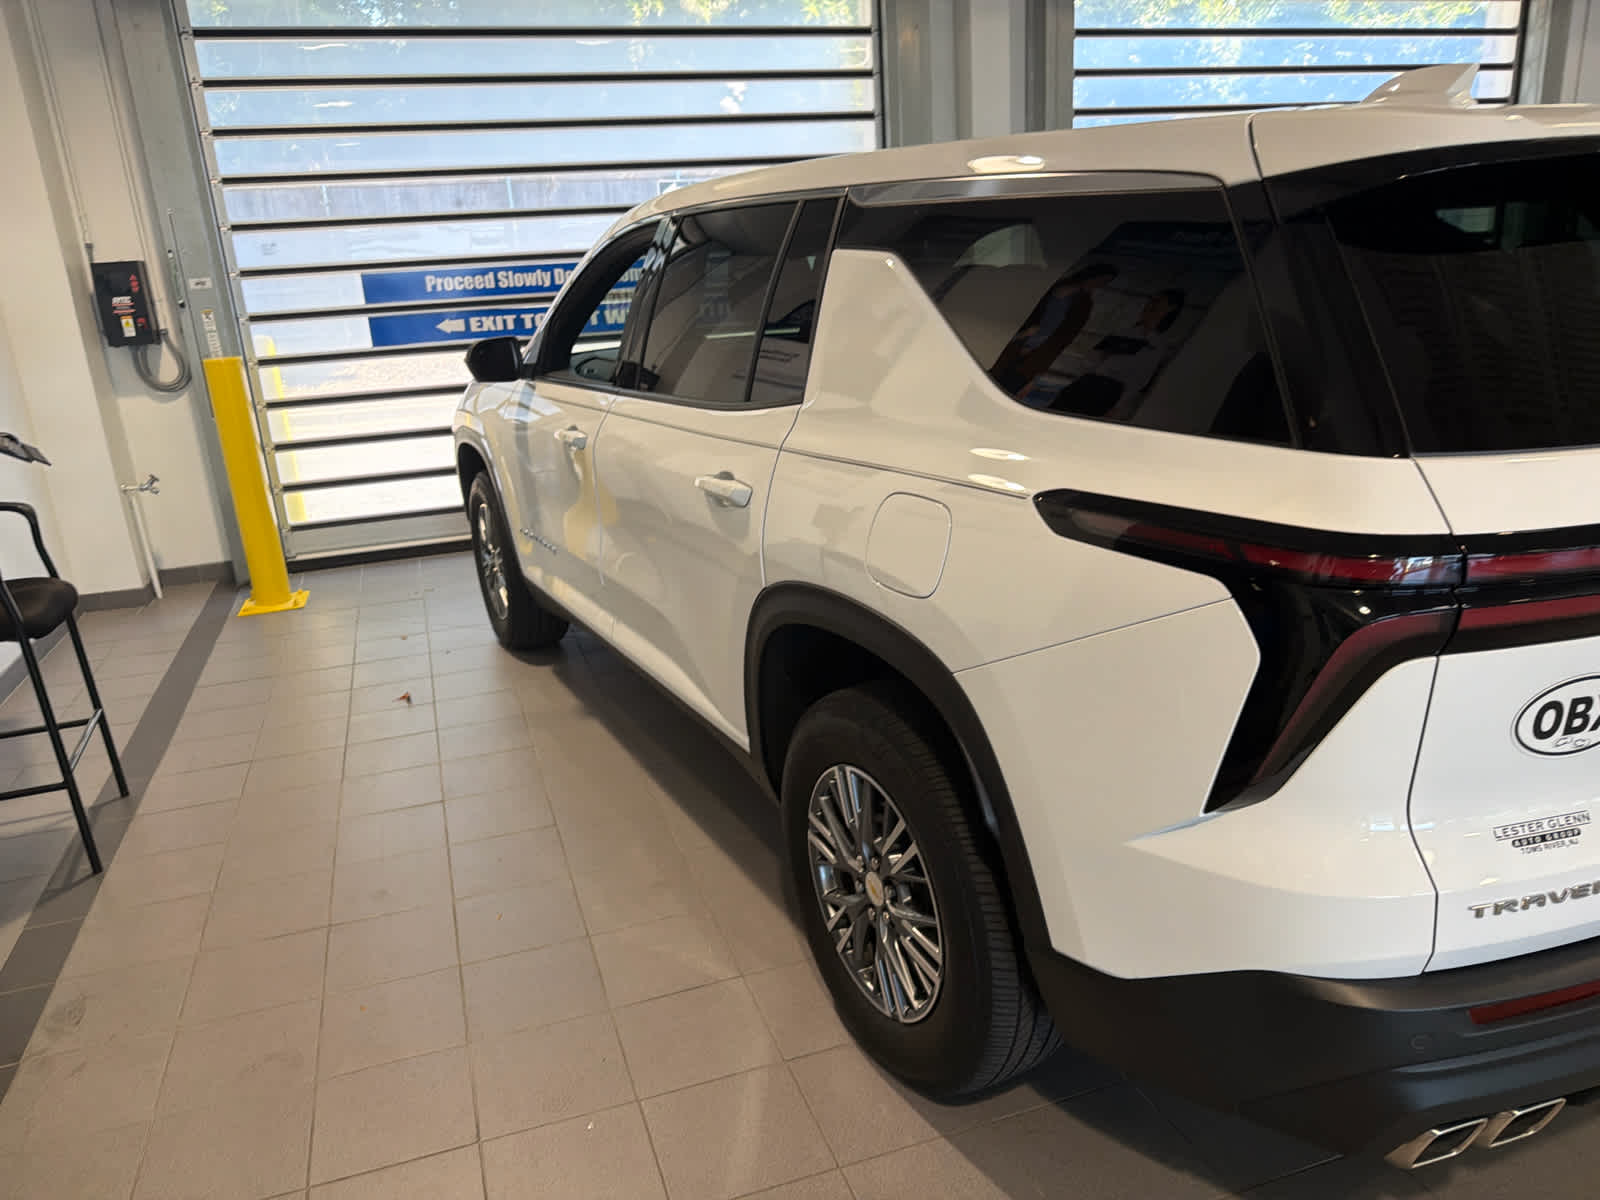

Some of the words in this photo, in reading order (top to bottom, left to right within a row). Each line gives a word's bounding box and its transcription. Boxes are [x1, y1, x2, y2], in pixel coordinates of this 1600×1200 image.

[425, 271, 496, 292] Proceed
[497, 268, 551, 287] Slowly
[469, 315, 517, 332] EXIT
[1493, 821, 1545, 839] LESTER
[1546, 812, 1590, 829] GLENN
